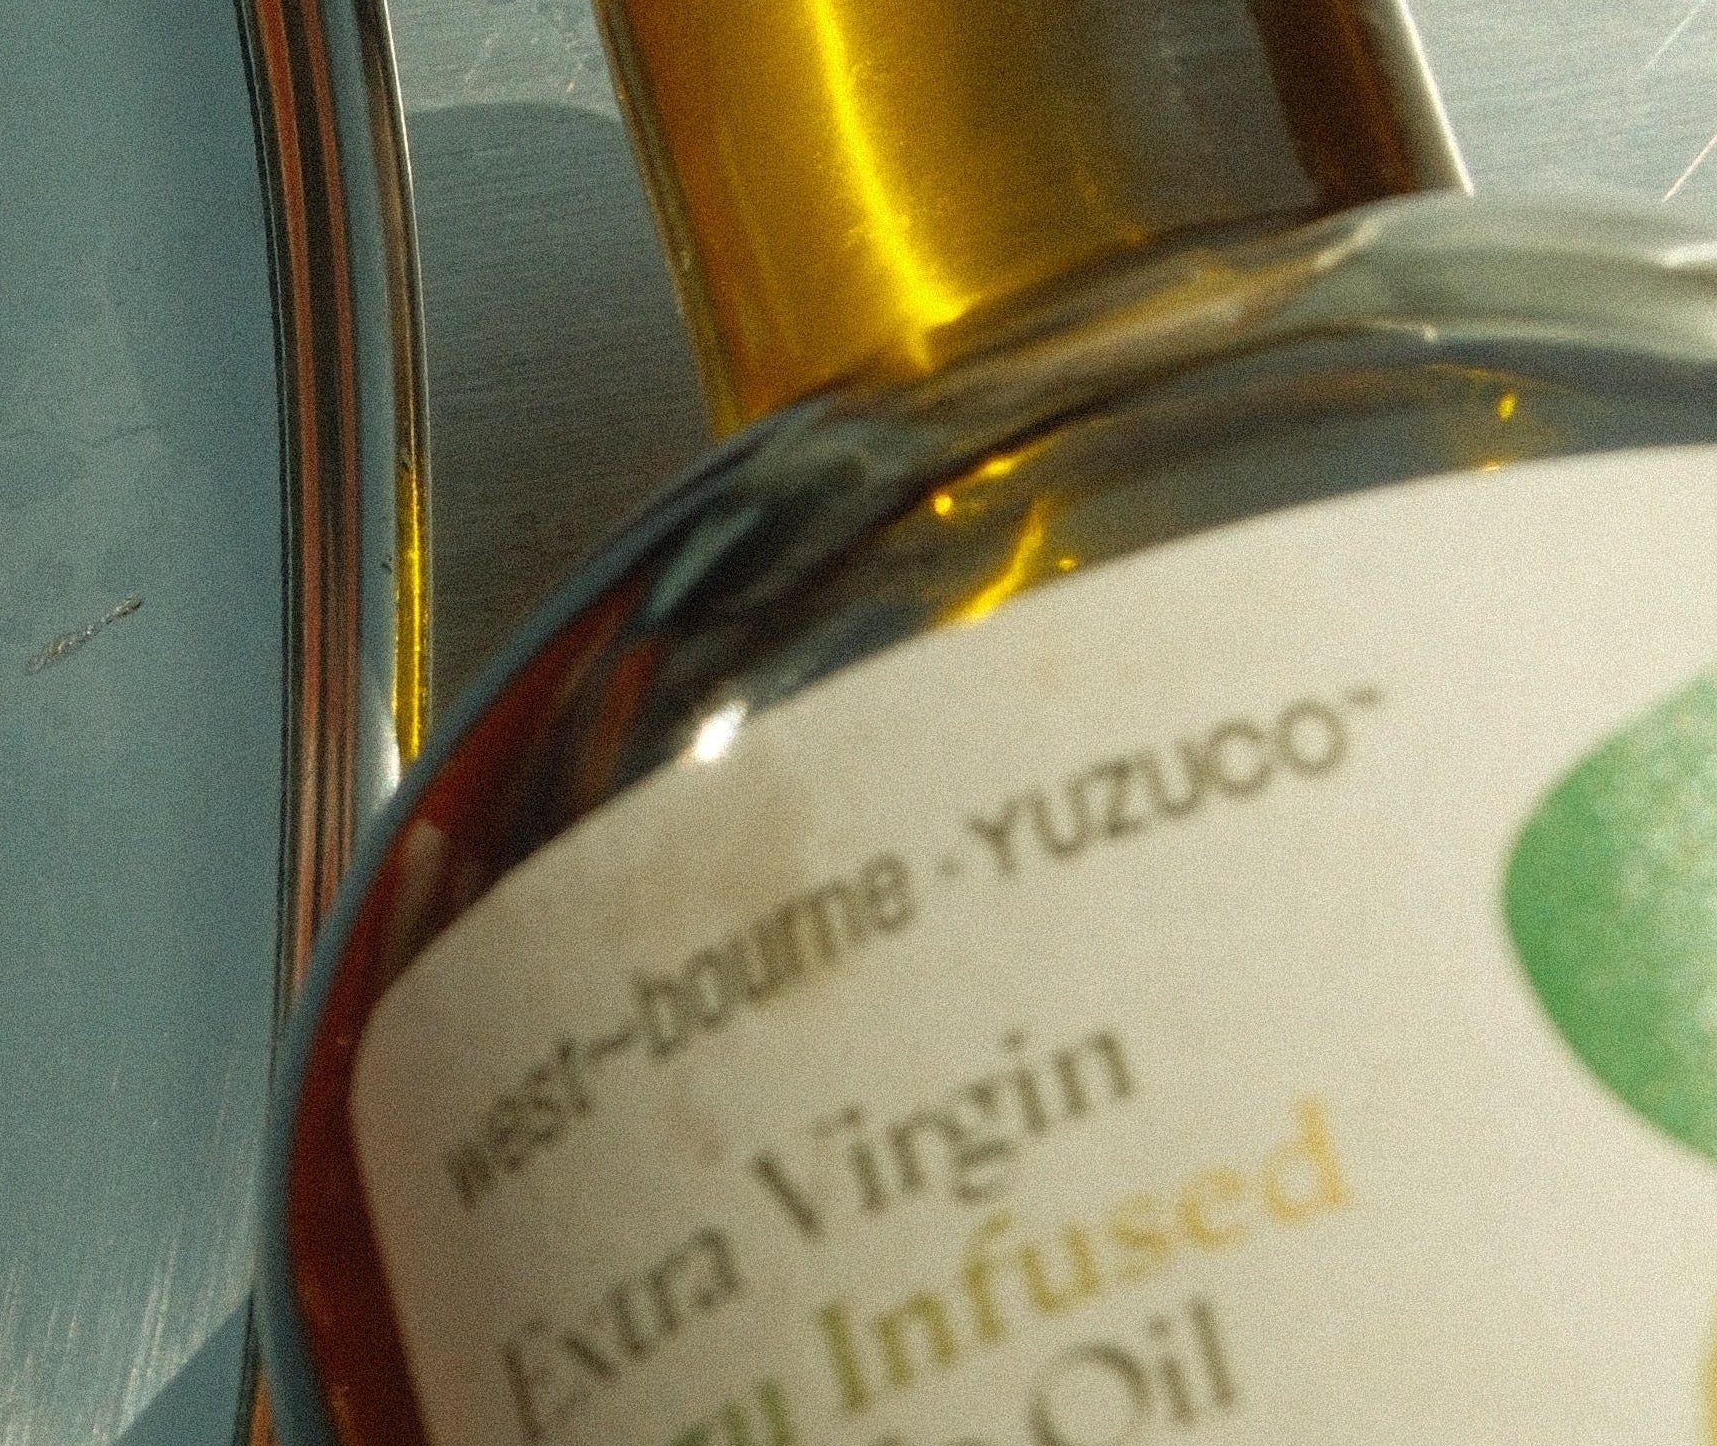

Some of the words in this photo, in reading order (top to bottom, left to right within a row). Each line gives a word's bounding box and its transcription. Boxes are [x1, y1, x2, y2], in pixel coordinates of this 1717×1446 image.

[500, 1226, 745, 1446] Extra
[749, 1024, 1138, 1245] Virgin
[813, 1096, 1352, 1419] Infused
